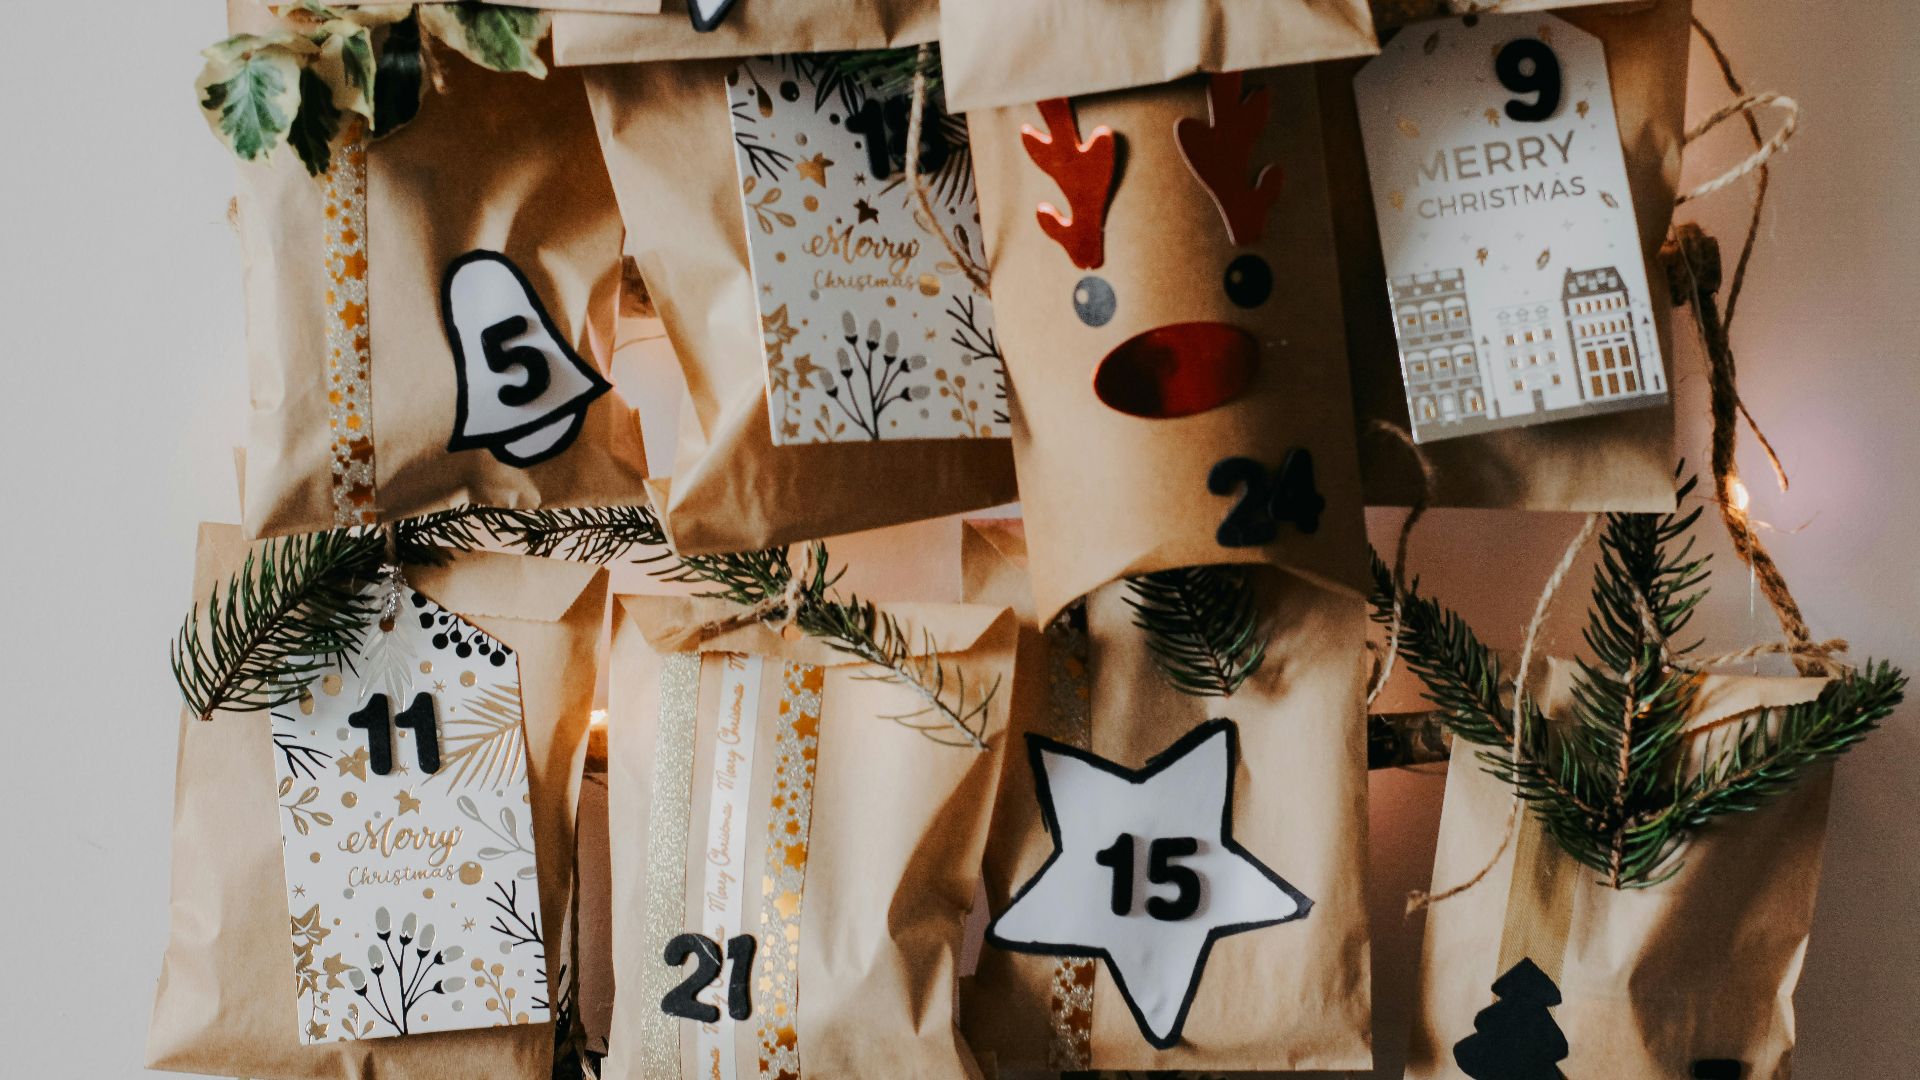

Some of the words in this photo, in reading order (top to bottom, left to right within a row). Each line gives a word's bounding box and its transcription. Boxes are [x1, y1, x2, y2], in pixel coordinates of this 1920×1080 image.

[1495, 38, 1562, 122] 9
[1416, 130, 1574, 186] MERRY
[1418, 177, 1585, 219] CHRISTMAS
[803, 224, 920, 275] Merry
[813, 269, 916, 291] Christmas
[480, 315, 549, 407] 5
[1206, 448, 1326, 549] 24
[348, 692, 440, 776] 11
[338, 816, 464, 868] Merry
[348, 864, 456, 888] Christmas
[1095, 832, 1200, 921] 15
[661, 932, 757, 1024] 21
